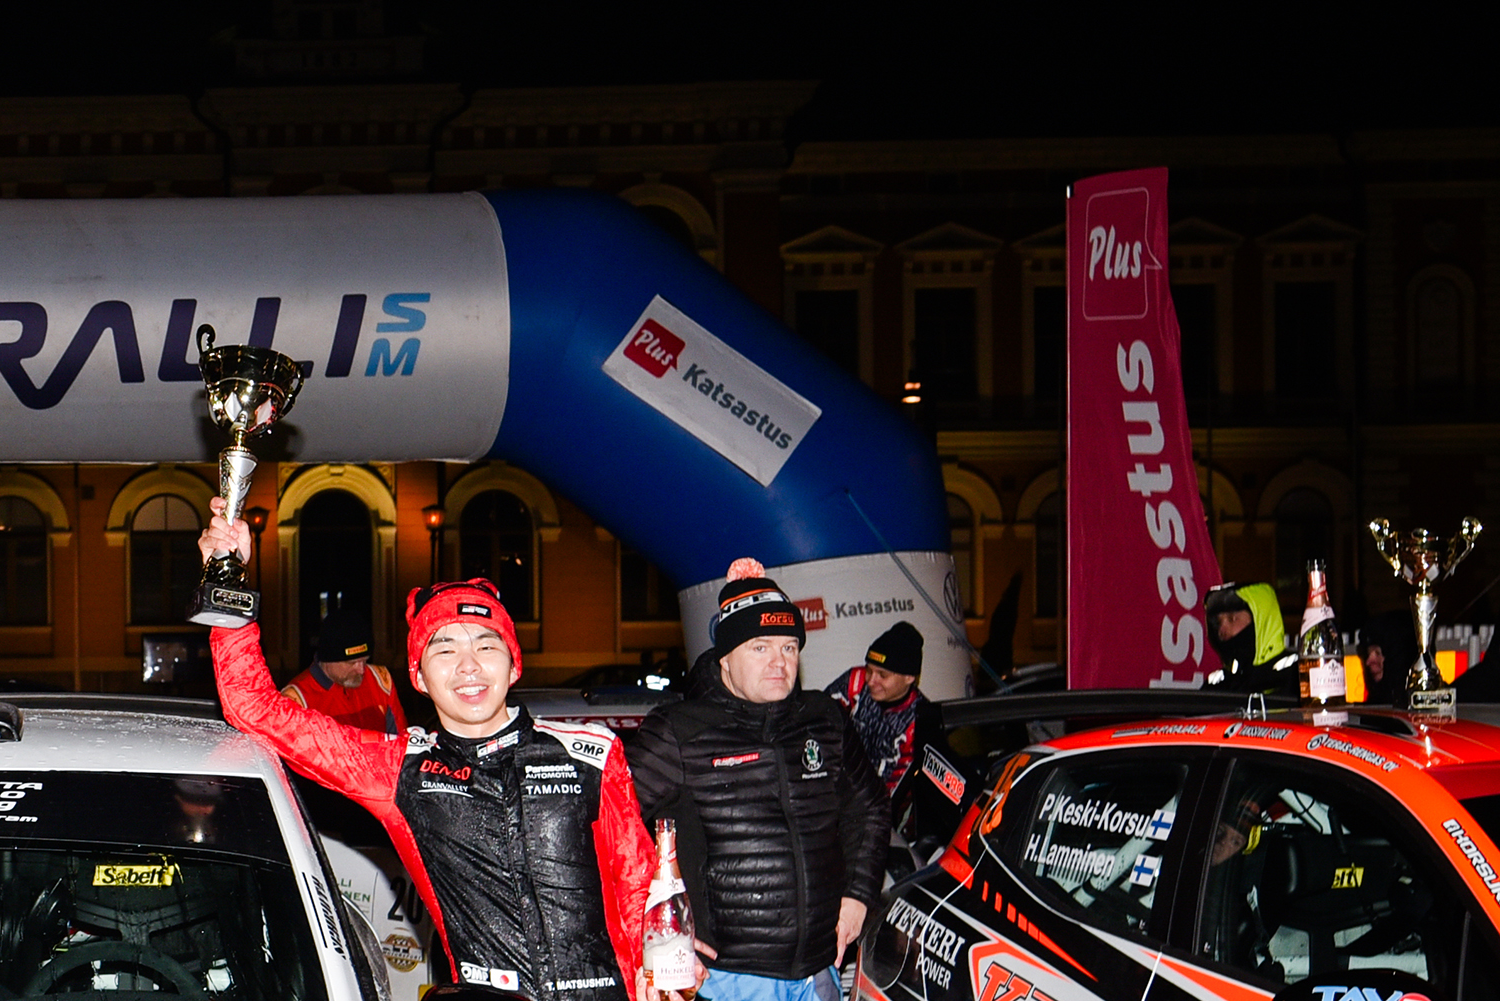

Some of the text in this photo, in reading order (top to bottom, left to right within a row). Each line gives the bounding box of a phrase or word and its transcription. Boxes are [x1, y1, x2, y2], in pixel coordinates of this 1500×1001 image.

[1088, 225, 1142, 281] Plus
[633, 329, 674, 367] Plus
[682, 364, 793, 451] Katsastus
[835, 597, 915, 618] Katsastus
[759, 611, 796, 627] Korsu
[572, 742, 606, 757] OMP
[525, 763, 576, 774] Panasonic
[525, 770, 579, 780] AUTOMOTIVE
[421, 780, 469, 793] GRANVALLEY
[525, 784, 583, 796] TAMADIC
[387, 876, 424, 926] 20
[885, 896, 966, 967] WETTERI
[460, 965, 489, 982] OMP
[916, 956, 951, 990] POWER
[556, 976, 617, 990] MATSUSHITA
